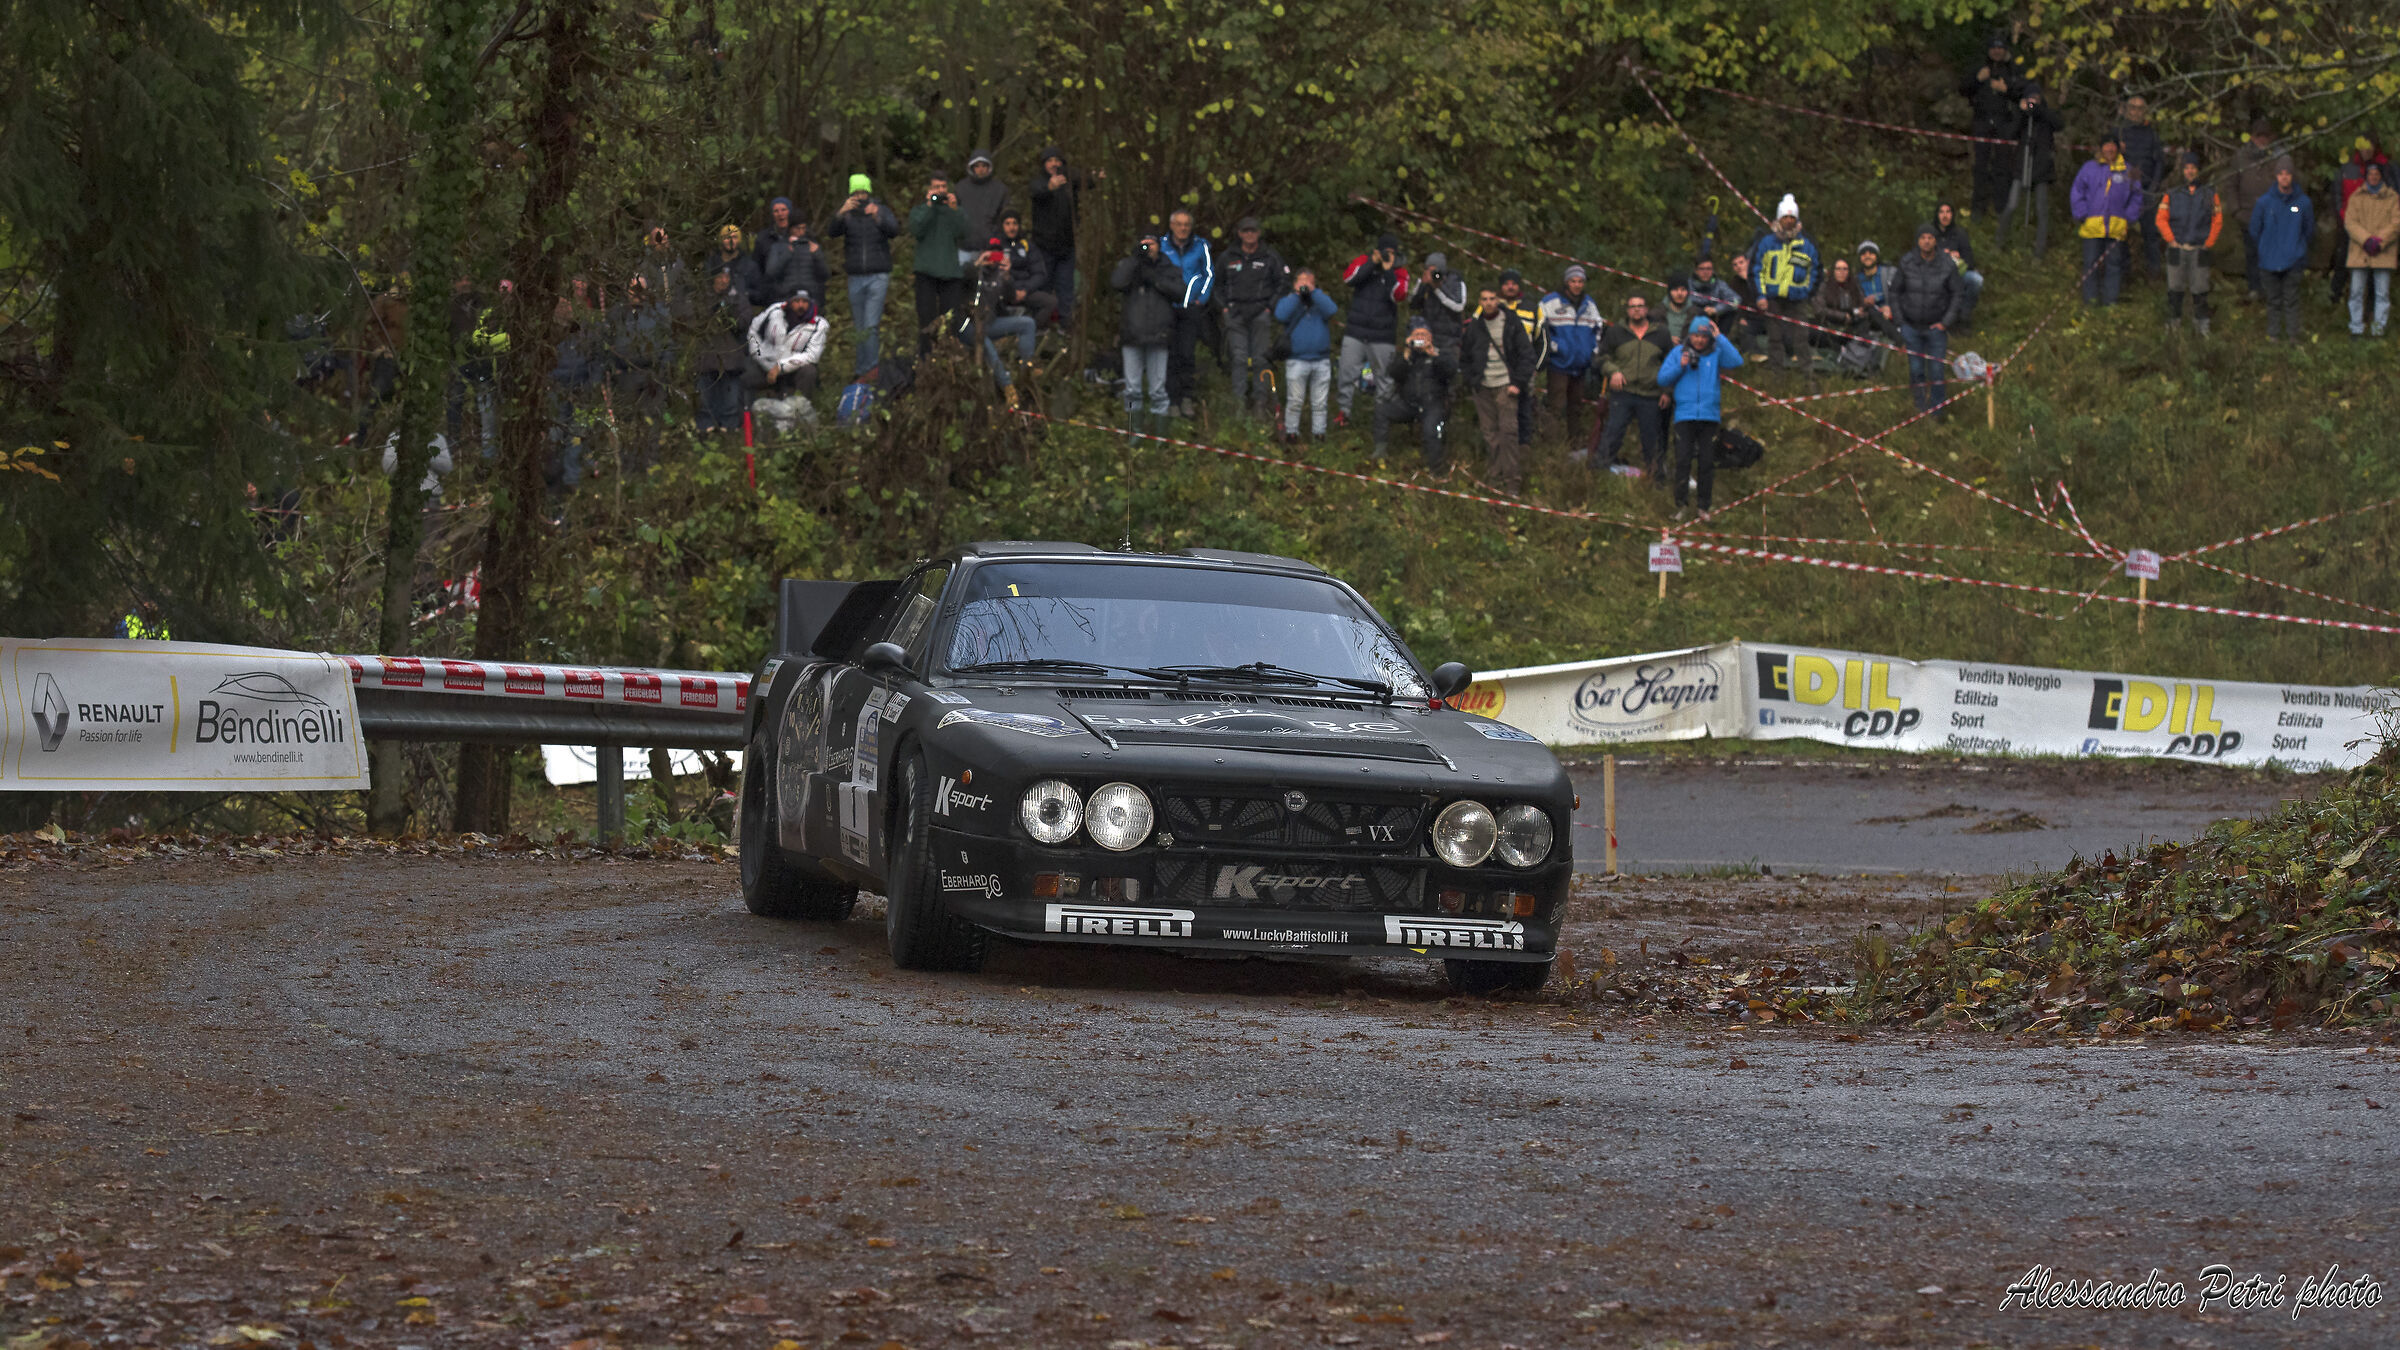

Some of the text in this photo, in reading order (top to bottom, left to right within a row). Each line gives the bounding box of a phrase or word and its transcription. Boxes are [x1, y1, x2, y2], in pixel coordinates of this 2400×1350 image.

[1007, 583, 1020, 597] 1
[506, 679, 544, 692] PERICOLOSA
[1756, 651, 1902, 712] EDIL
[1958, 668, 2062, 691] Vendita Noleggio
[565, 683, 603, 696] PERICOLOSA
[625, 687, 661, 700] PERICOLOSA
[683, 691, 718, 705] PERICOLOSA
[1954, 689, 1999, 708] Edilizia
[2087, 678, 2224, 736] EDIL
[2281, 689, 2391, 712] Vendita Noleggio
[78, 703, 165, 725] RENAULT
[195, 700, 345, 745] Bendinelli
[1843, 707, 1922, 738] CDP
[1951, 711, 1985, 730] Sport
[2277, 710, 2324, 729] Edilizia
[79, 729, 143, 744] Passion for life
[1946, 732, 2012, 751] Spettacolo
[2272, 732, 2307, 752] Sport
[233, 751, 304, 764] www.bendinelli.it
[850, 786, 857, 829] 1
[1368, 825, 1395, 842] VX
[940, 869, 988, 889] EBERHARD
[1044, 903, 1196, 937] PIRELLI
[1222, 927, 1349, 944] www.LuckyBattistolli.it
[1383, 914, 1525, 951] PIRELLI
